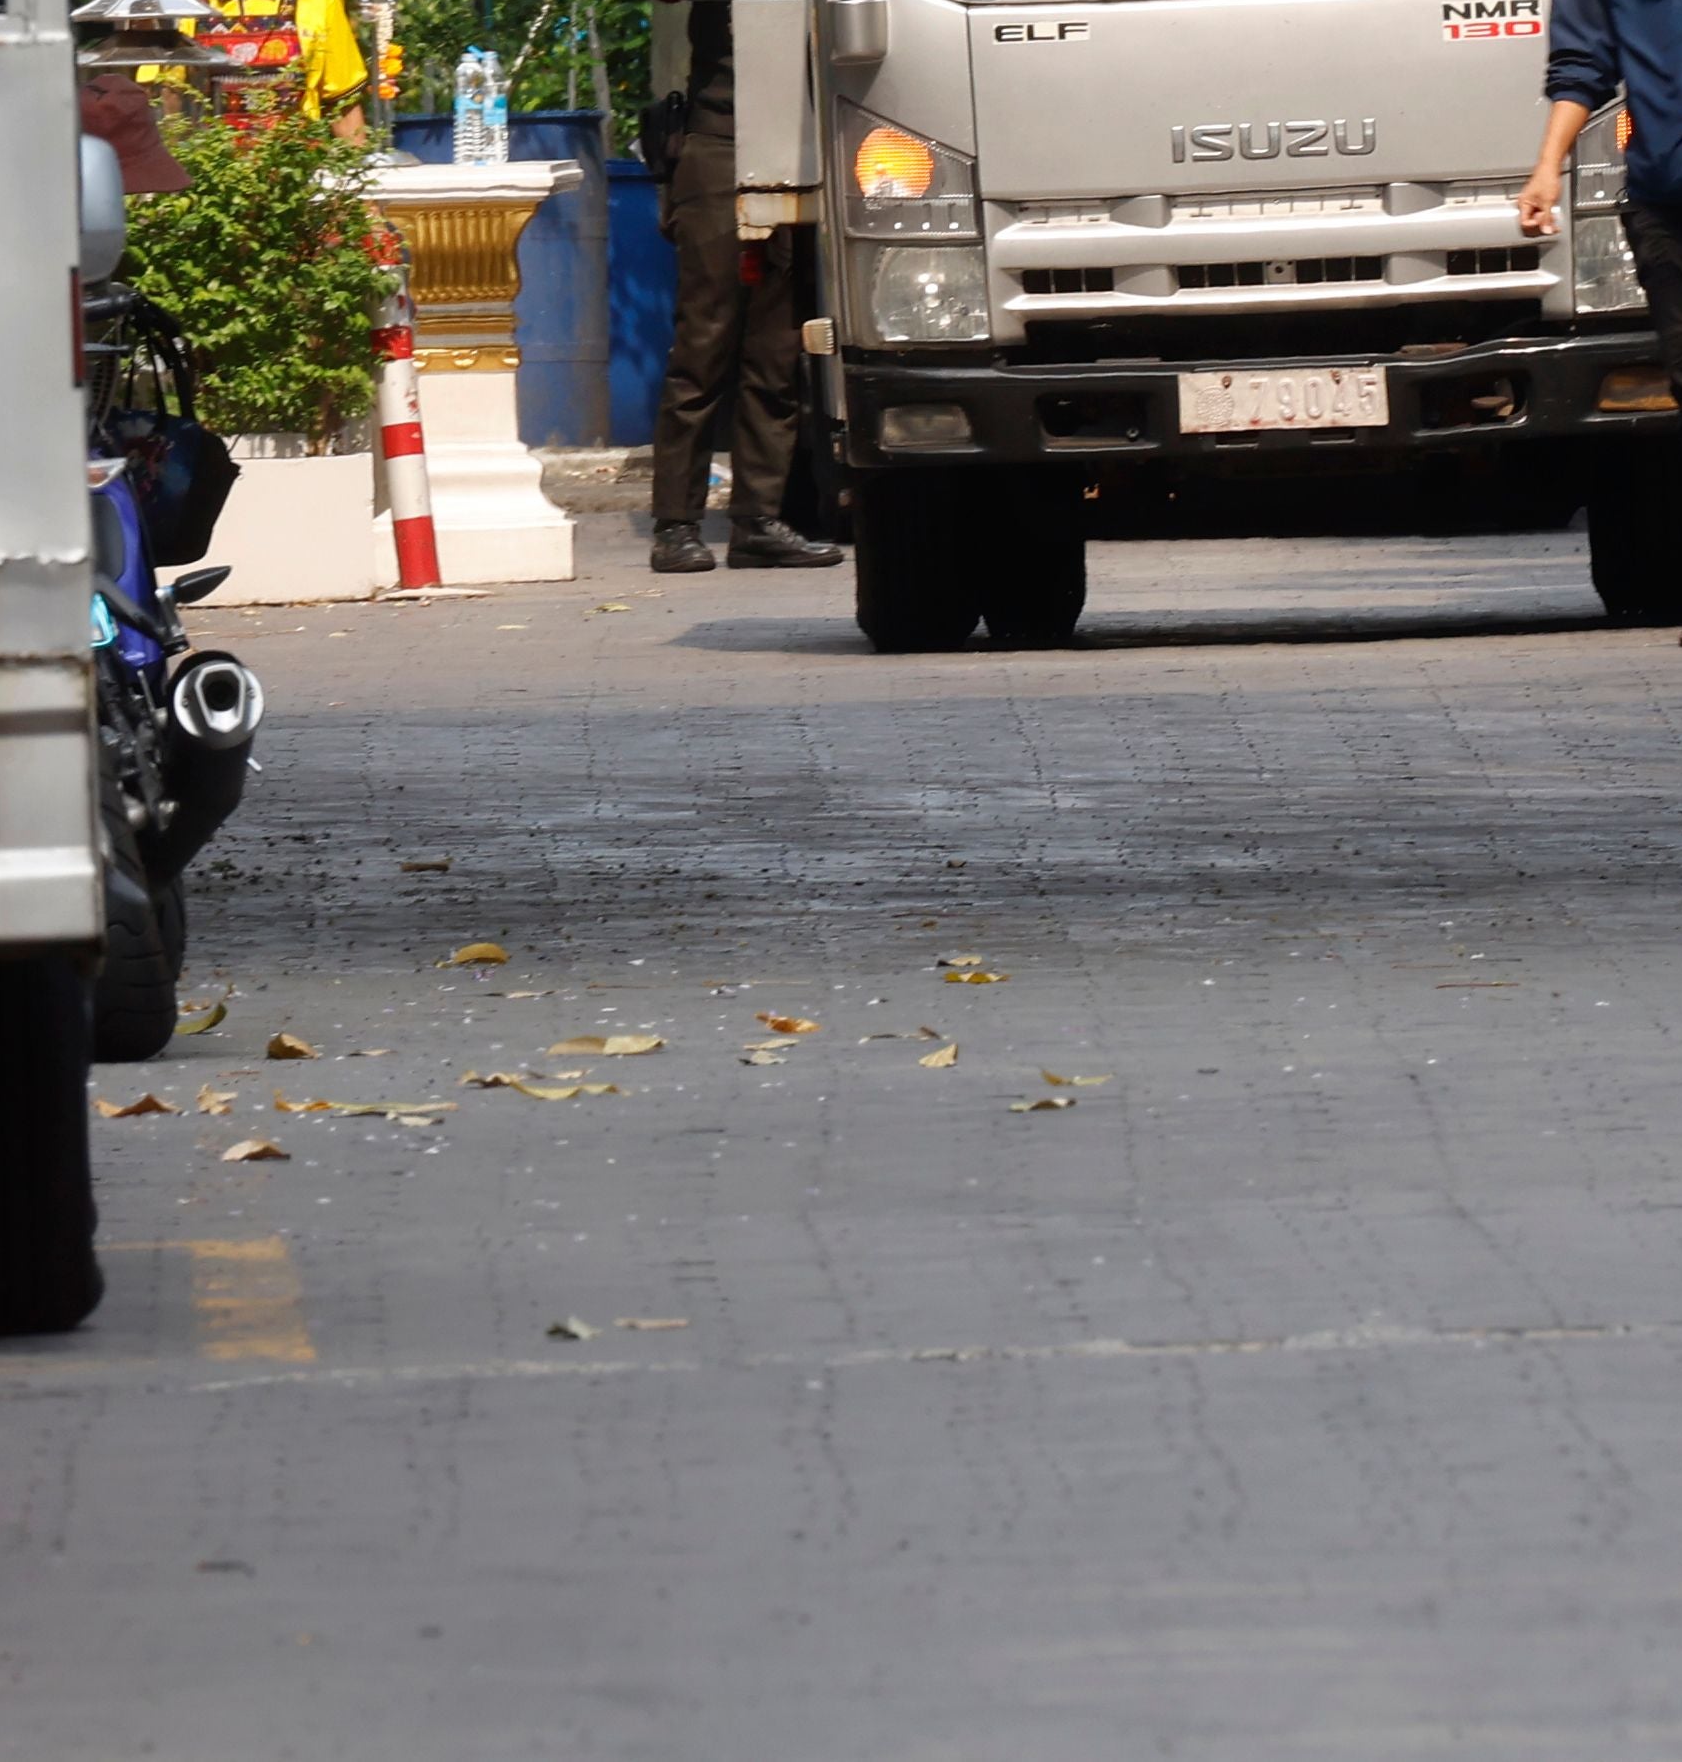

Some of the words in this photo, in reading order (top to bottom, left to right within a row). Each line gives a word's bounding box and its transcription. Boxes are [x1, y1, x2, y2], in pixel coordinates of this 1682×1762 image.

[1443, 0, 1540, 20] NMR
[994, 22, 1089, 42] ELF
[1443, 21, 1541, 39] 130
[1171, 117, 1376, 164] ISUZU
[1247, 373, 1378, 421] 79045
